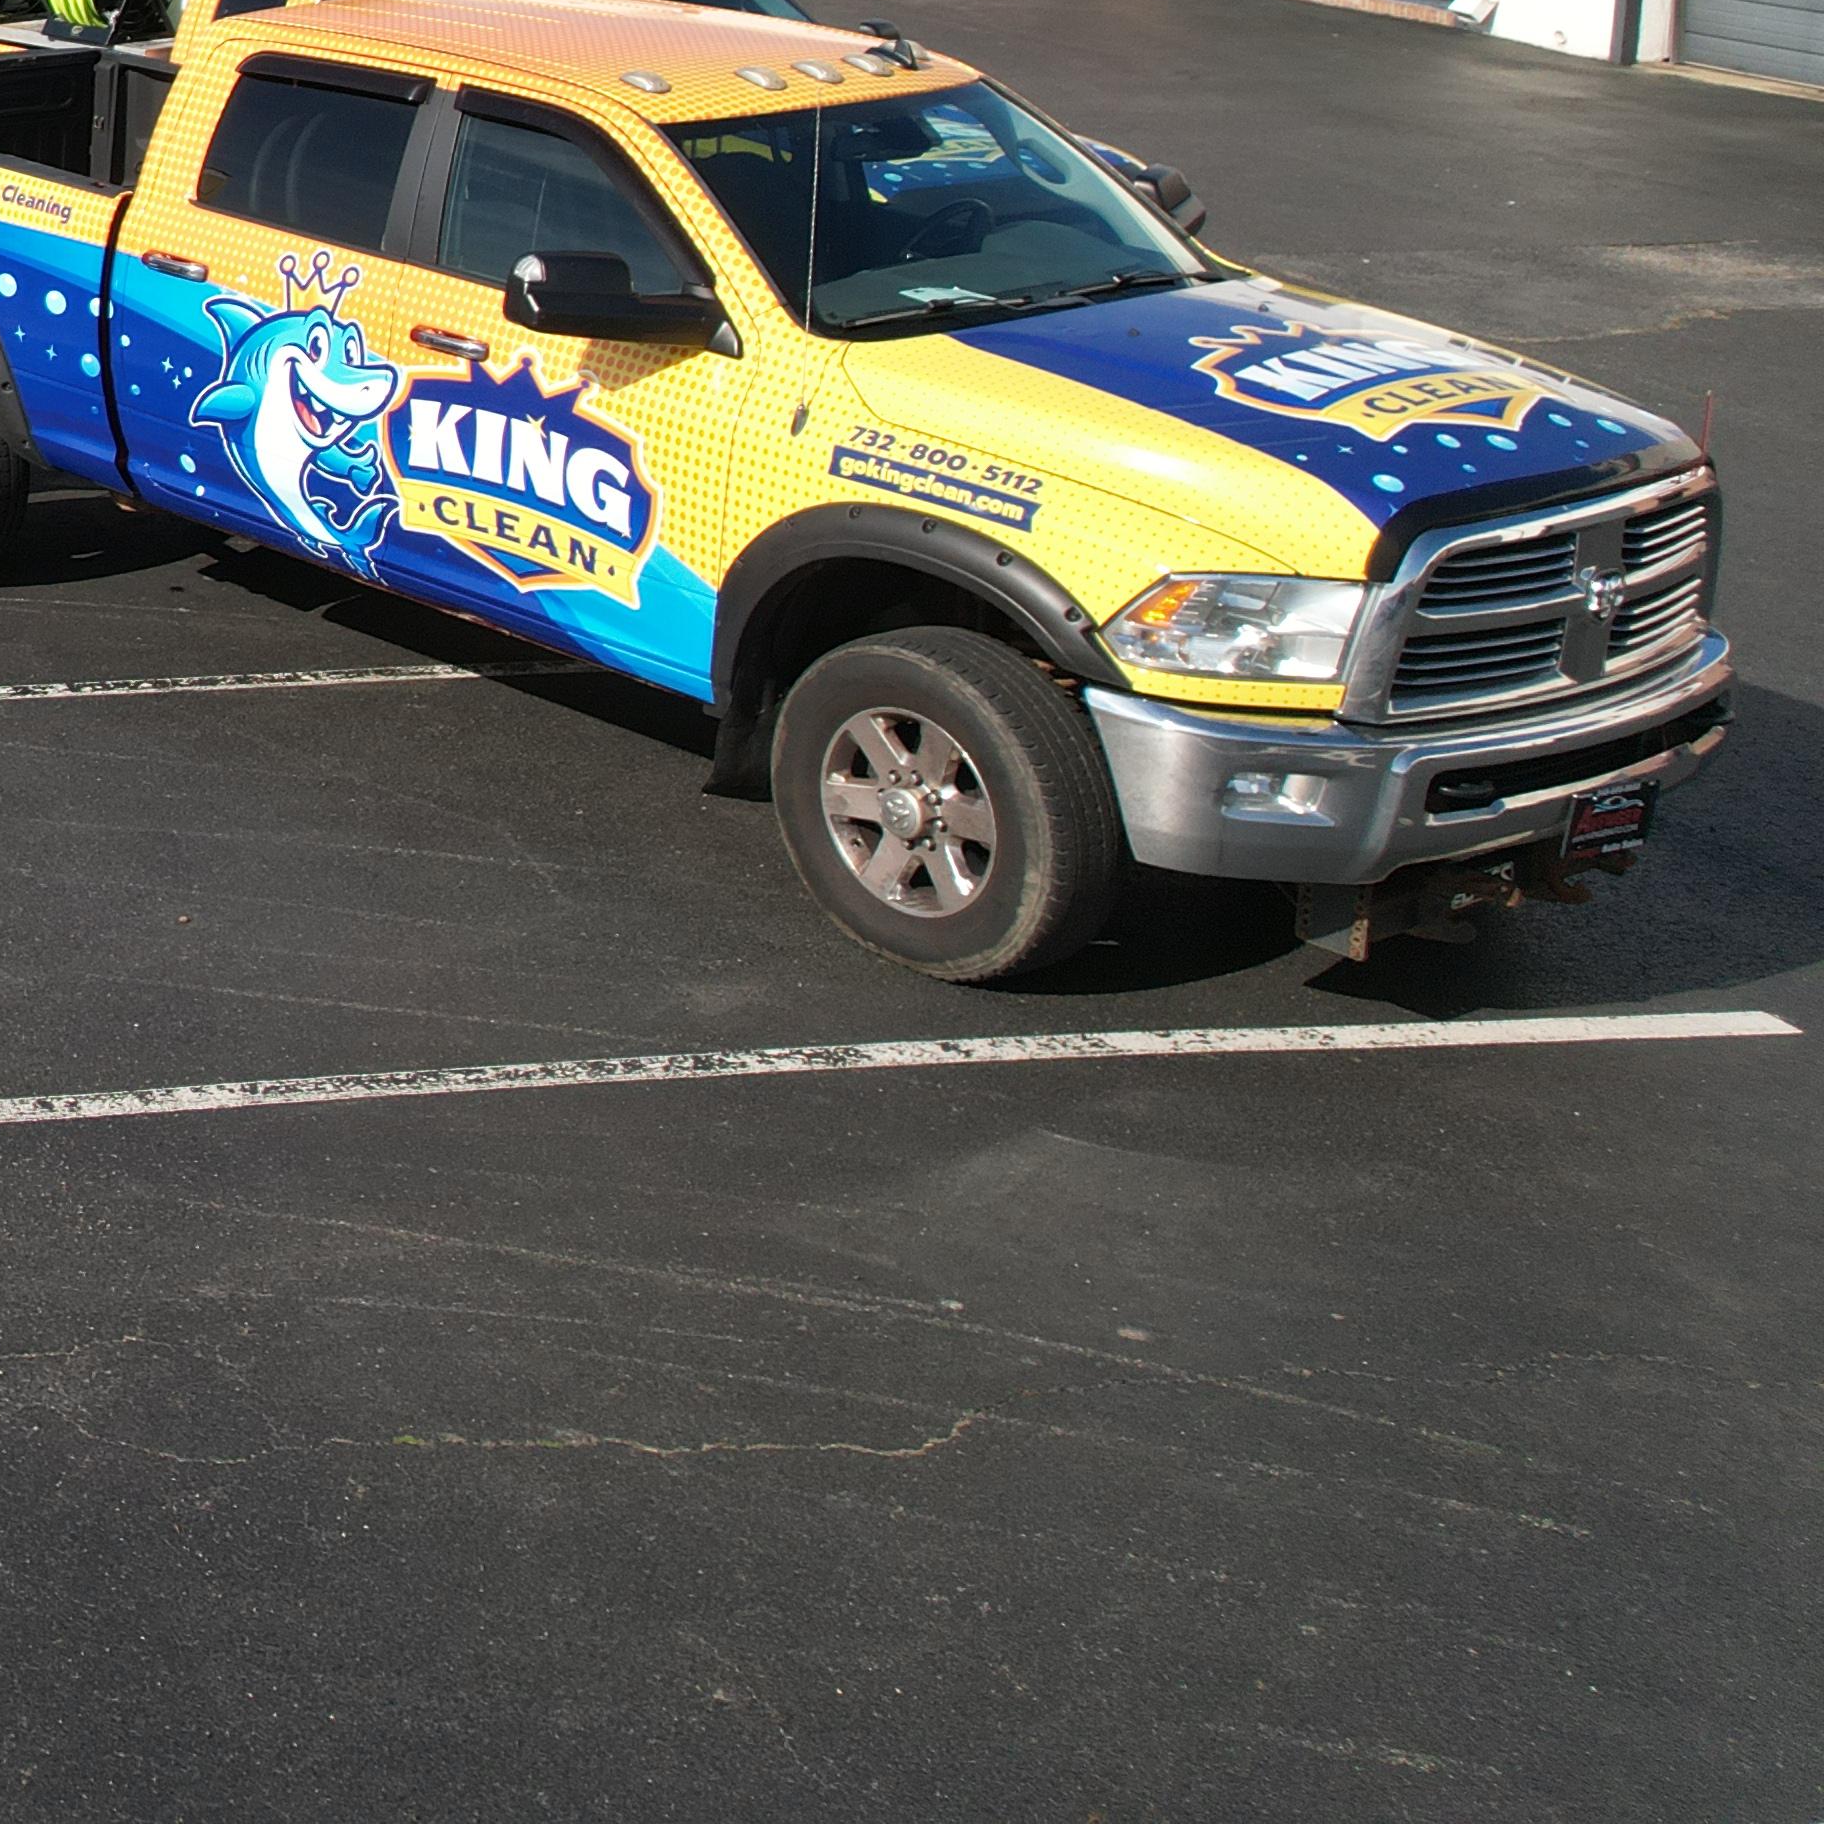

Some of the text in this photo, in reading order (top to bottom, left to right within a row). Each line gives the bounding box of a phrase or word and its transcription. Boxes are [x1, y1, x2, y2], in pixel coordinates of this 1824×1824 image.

[2, 185, 72, 224] Cleaning
[1234, 340, 1482, 402] KING
[1364, 375, 1526, 415] CLEAN
[408, 398, 632, 538] KING
[839, 456, 1025, 521] gokingclean.com
[433, 495, 598, 575] CLEAN
